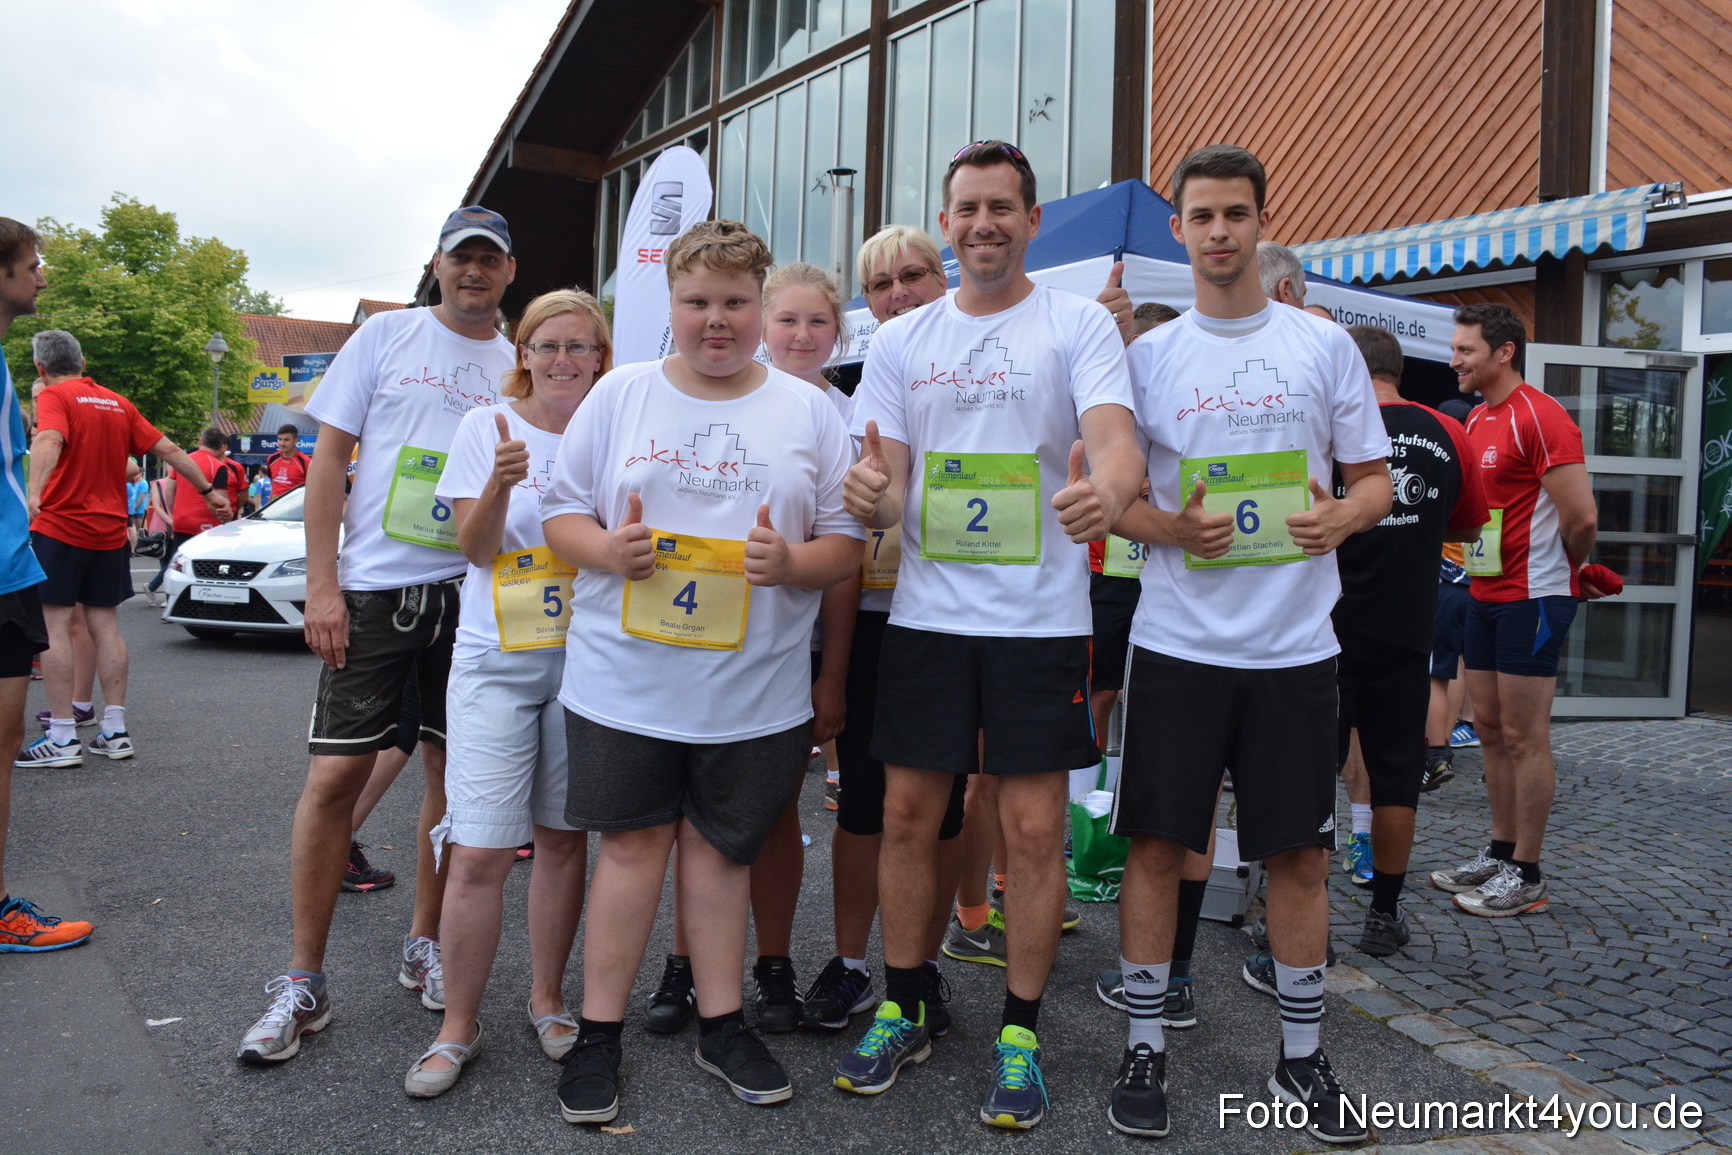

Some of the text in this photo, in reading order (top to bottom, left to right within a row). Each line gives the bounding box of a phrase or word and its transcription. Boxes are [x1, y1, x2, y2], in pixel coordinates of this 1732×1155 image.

[637, 248, 667, 264] SE
[1329, 305, 1427, 339] utomobile.de
[251, 376, 287, 391] Burgis
[910, 362, 1006, 391] aktives
[955, 386, 1026, 404] Neumarkt
[1176, 388, 1285, 421] aktives
[1228, 408, 1306, 428] Neumarkt
[1229, 428, 1249, 436] aktives
[1249, 426, 1276, 434] Neumarkt
[625, 439, 739, 477] aktives
[678, 471, 762, 492] Neumarkt
[936, 471, 977, 480] firmenlauf
[977, 476, 1001, 485] 2016
[1201, 473, 1245, 484] firmenlauf
[1246, 476, 1270, 486] 2016
[676, 487, 698, 495] aktives
[698, 489, 727, 500] Neumarkt
[1427, 486, 1439, 499] 60
[966, 497, 988, 532] 2
[1235, 499, 1260, 535] 6
[412, 523, 435, 534] Marius
[872, 531, 885, 561] 7
[956, 539, 1001, 548] Roland Kittel
[1252, 540, 1284, 550] Stachely
[511, 561, 549, 576] firmenlauf
[543, 585, 563, 618] 5
[672, 580, 698, 615] 4
[536, 626, 555, 634] Silvia
[660, 619, 706, 633] Beate Grgan
